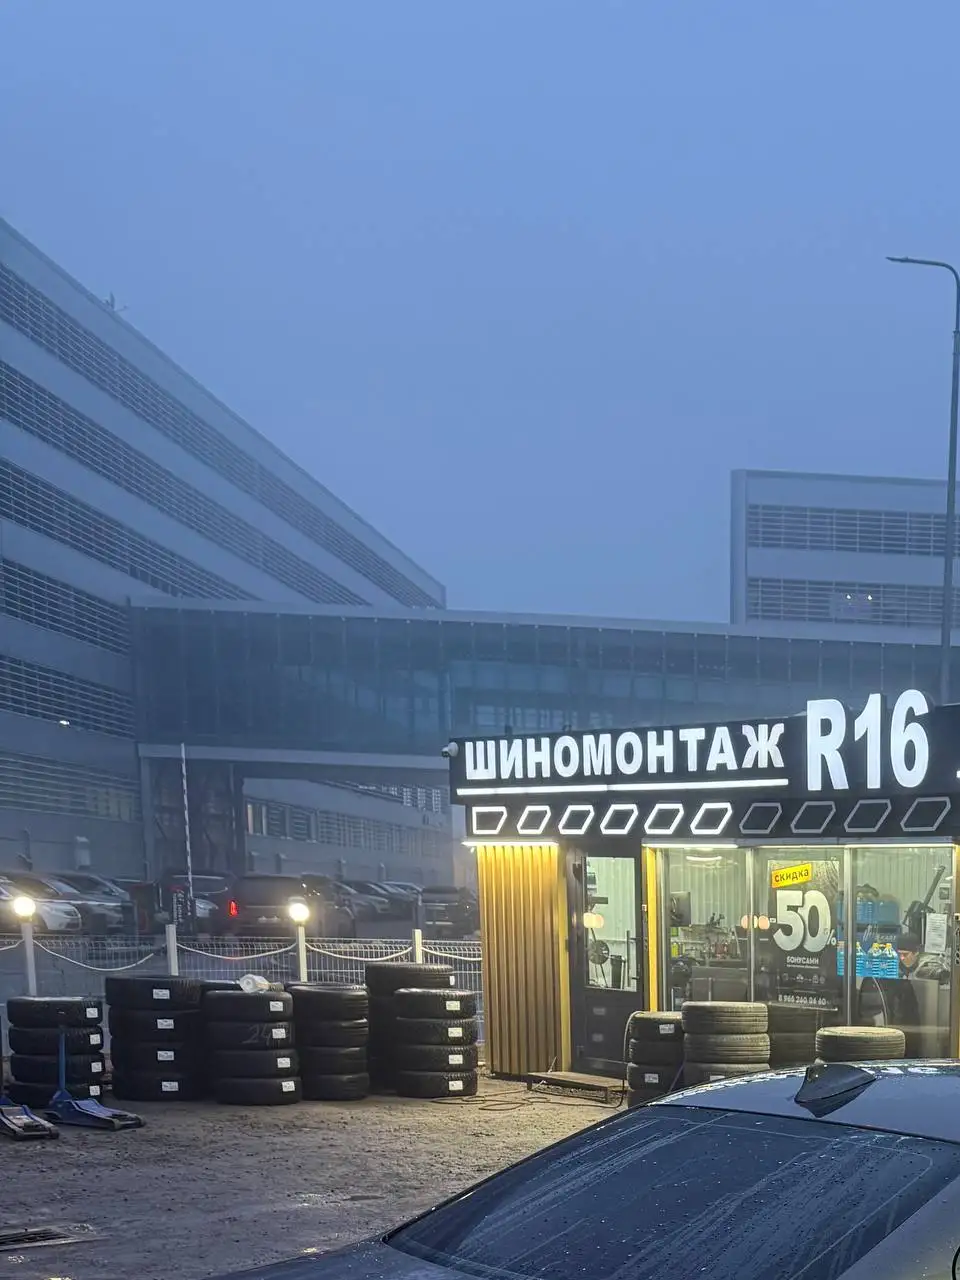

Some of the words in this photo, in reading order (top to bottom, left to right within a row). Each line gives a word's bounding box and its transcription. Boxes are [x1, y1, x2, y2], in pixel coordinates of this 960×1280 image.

[465, 723, 785, 780] ШИНОМОНТАЖ
[806, 689, 930, 791] R16
[774, 868, 809, 883] скидка
